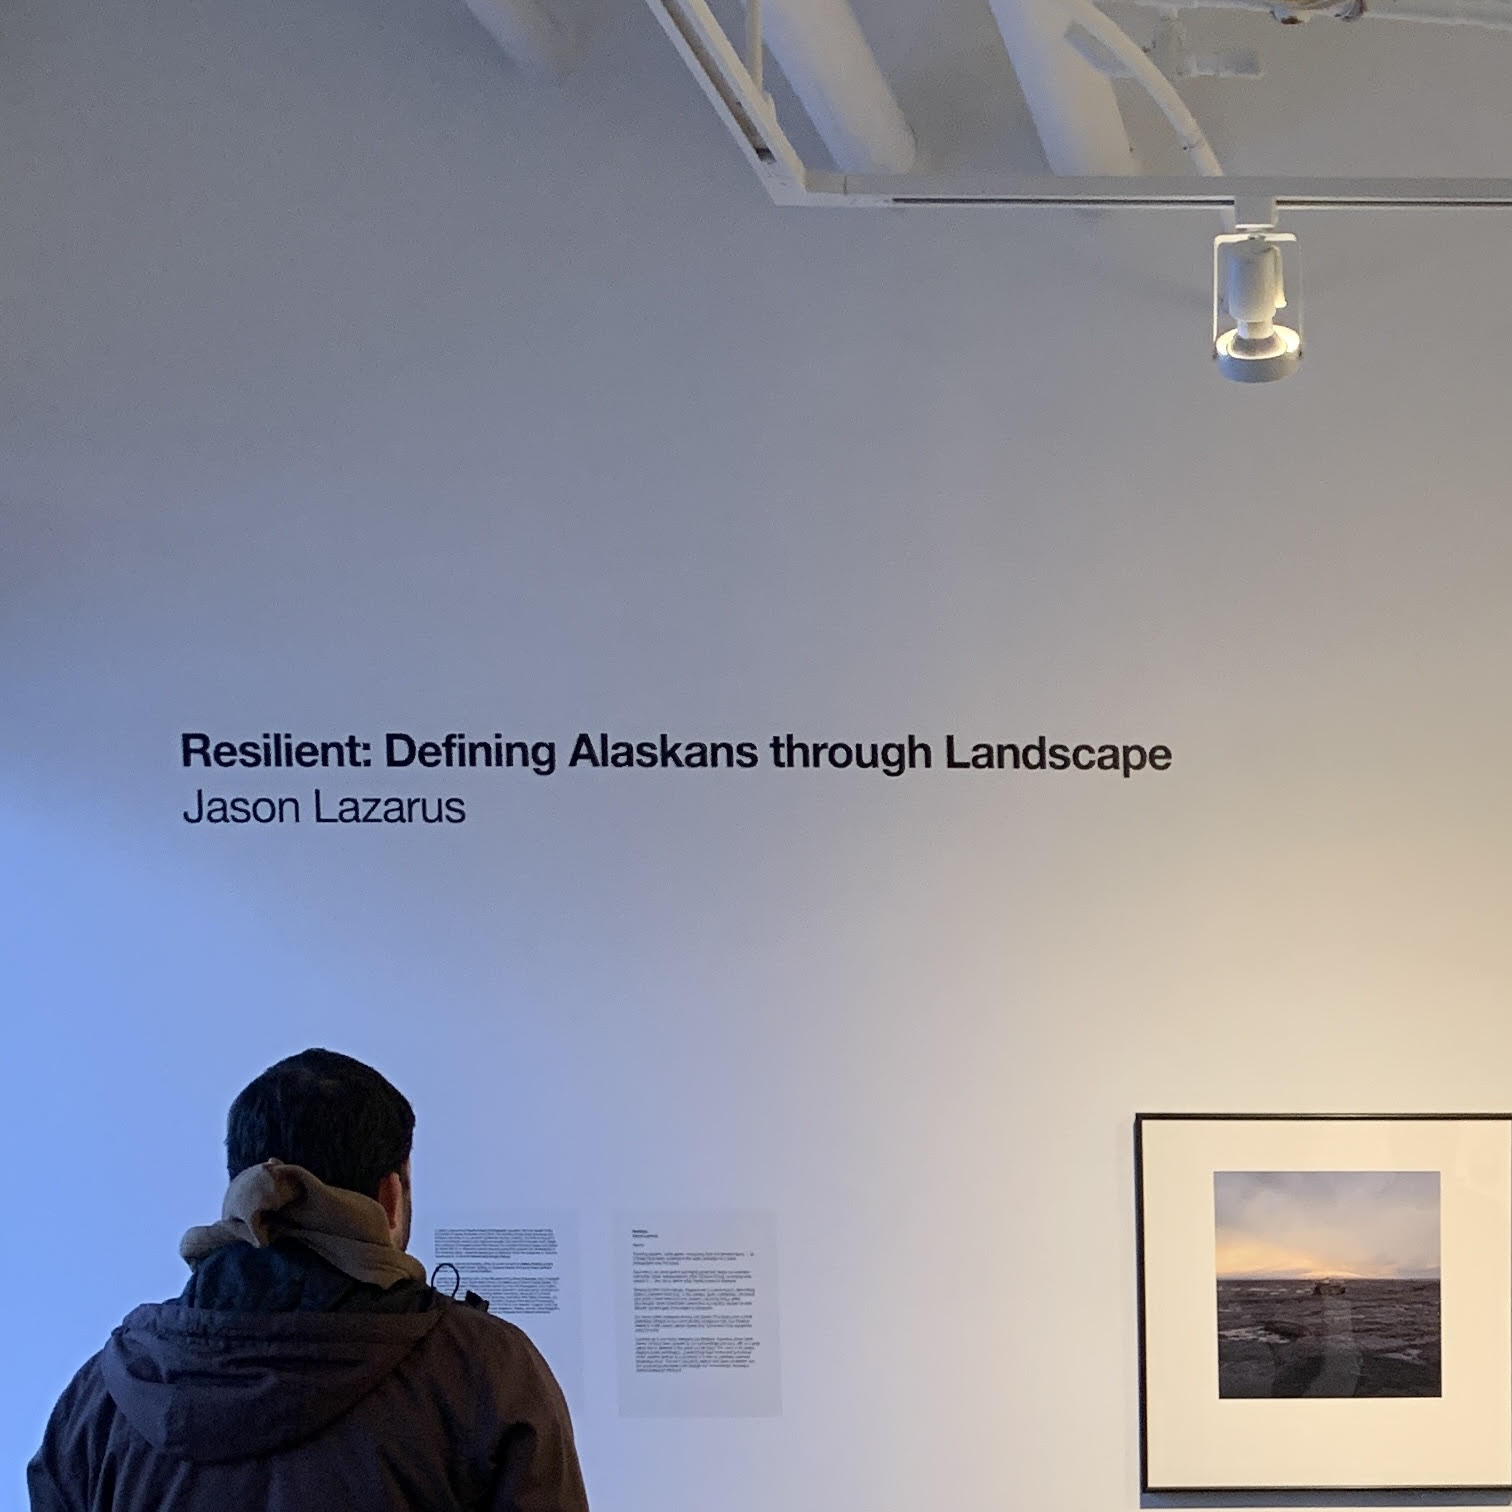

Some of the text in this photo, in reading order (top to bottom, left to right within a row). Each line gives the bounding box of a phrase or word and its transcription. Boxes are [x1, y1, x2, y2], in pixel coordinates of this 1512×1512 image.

[181, 732, 1173, 780] Resilient: Defining Alaskans through Landscape
[182, 787, 467, 825] Jason Lazarus
